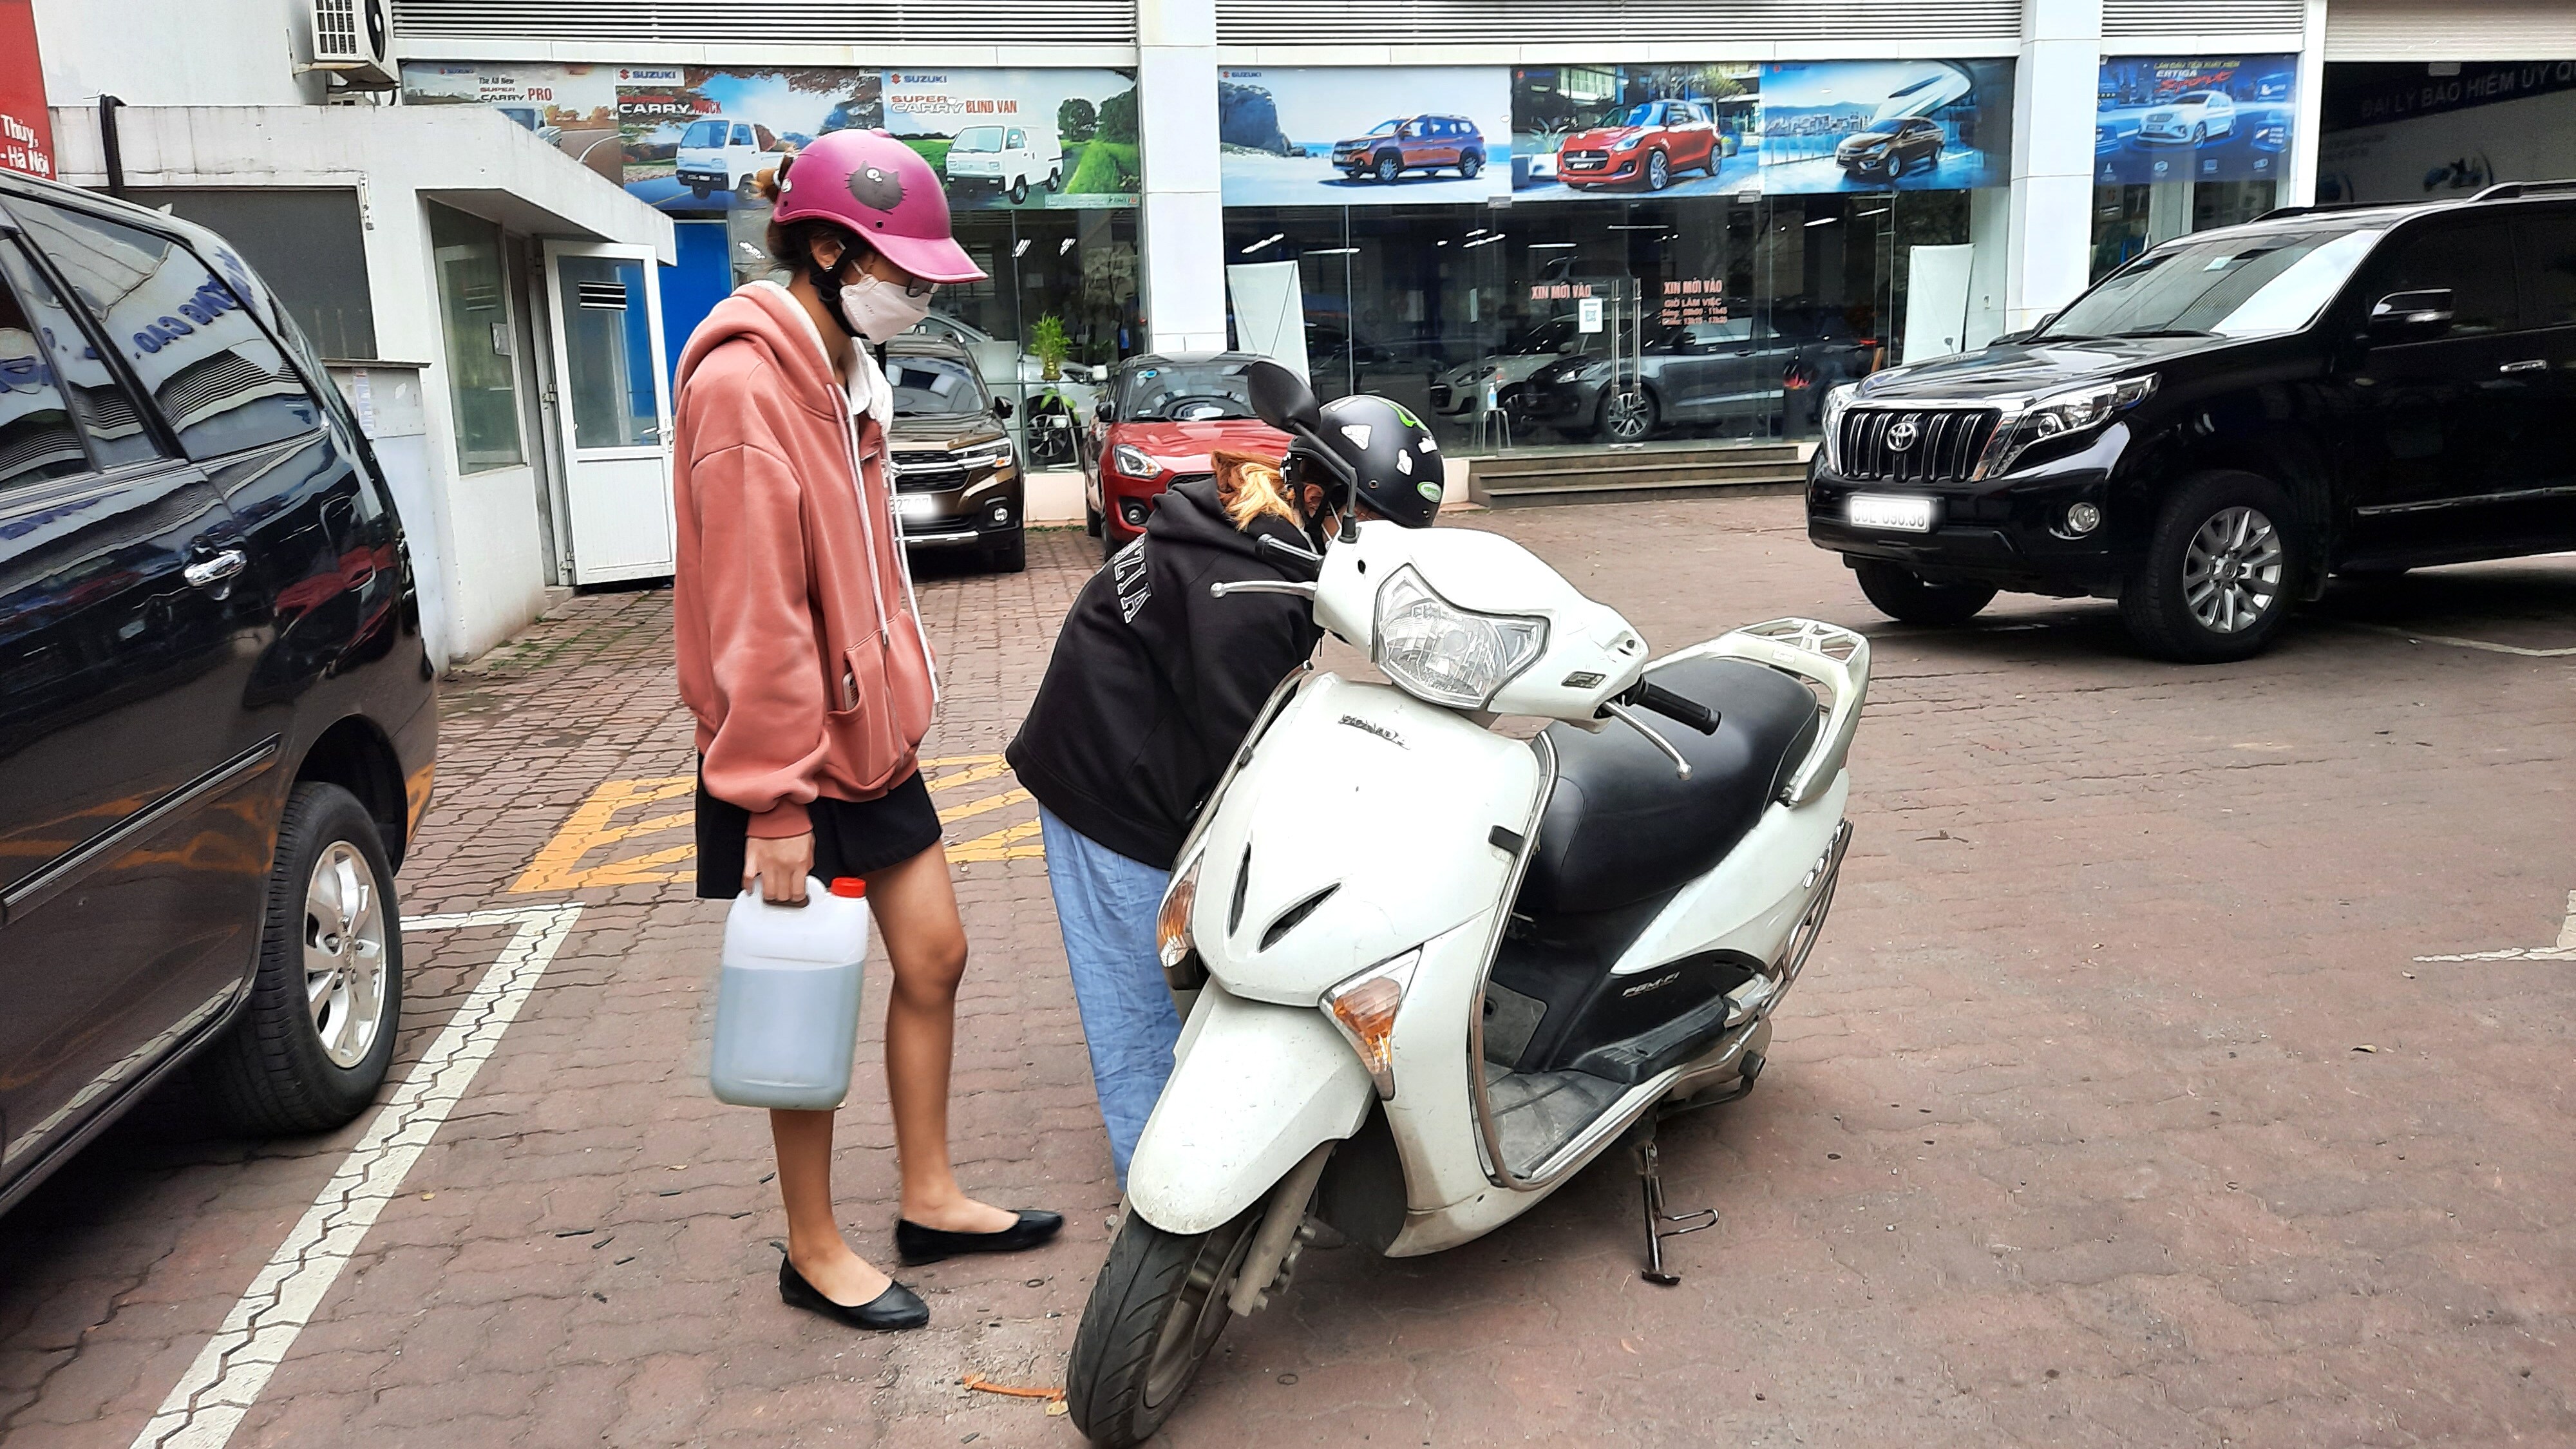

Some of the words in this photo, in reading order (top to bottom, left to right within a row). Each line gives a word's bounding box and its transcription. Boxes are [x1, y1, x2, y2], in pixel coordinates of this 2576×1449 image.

[632, 70, 676, 79] SUZUKI
[904, 75, 947, 83] SUZUKI
[2156, 70, 2198, 78] ERTIGA
[480, 94, 526, 102] CARRY
[527, 88, 553, 102] PRO
[891, 95, 947, 104] SUPER
[618, 103, 690, 114] CARRY
[891, 102, 965, 114] CARRY
[967, 100, 994, 113] BLIND
[997, 100, 1018, 113] VAN
[6, 145, 27, 169] Hà
[28, 149, 50, 177] Nội
[1531, 285, 1549, 300] XIN
[1663, 281, 1681, 295] XIN
[1338, 714, 1410, 750] HONDA
